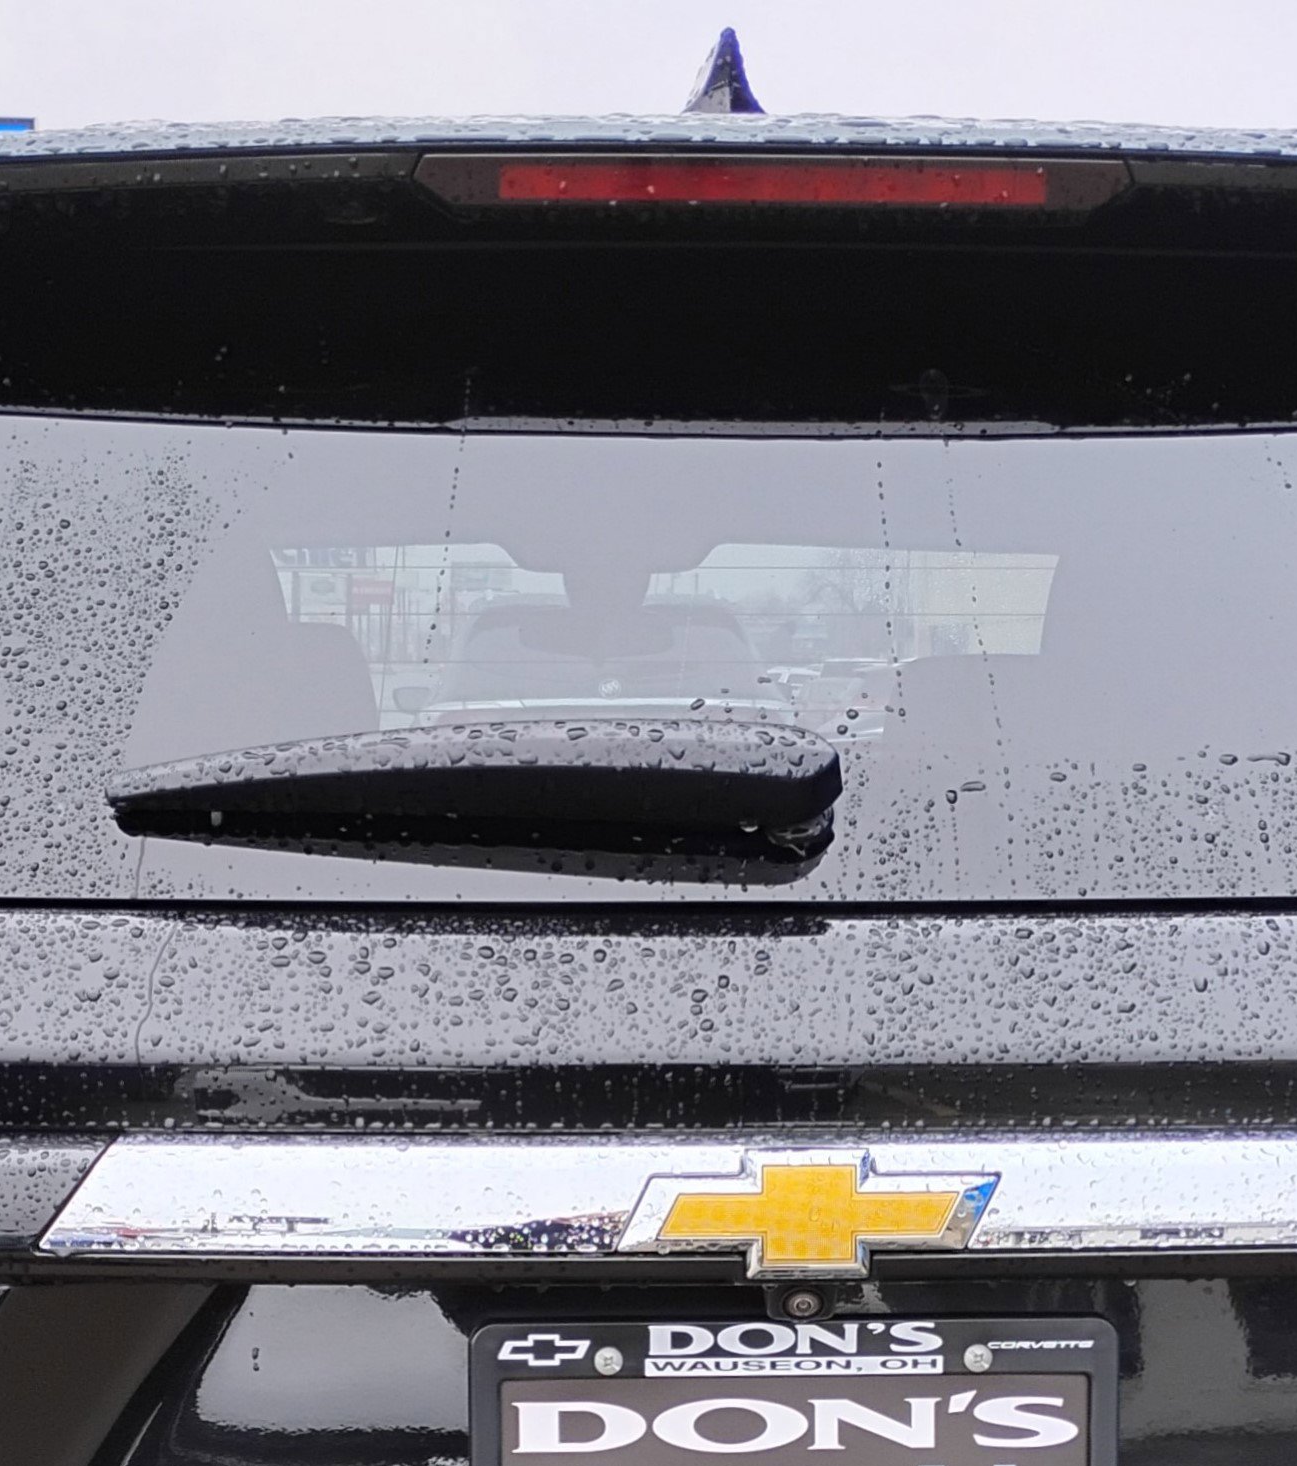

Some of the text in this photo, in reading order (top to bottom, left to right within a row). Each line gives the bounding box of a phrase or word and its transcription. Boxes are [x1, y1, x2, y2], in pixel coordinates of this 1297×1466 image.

[648, 1321, 943, 1356] DON'S
[987, 1340, 1095, 1350] CORVETTE
[651, 1357, 938, 1373] WAUSEON, OH
[511, 1390, 1079, 1454] DON'S
